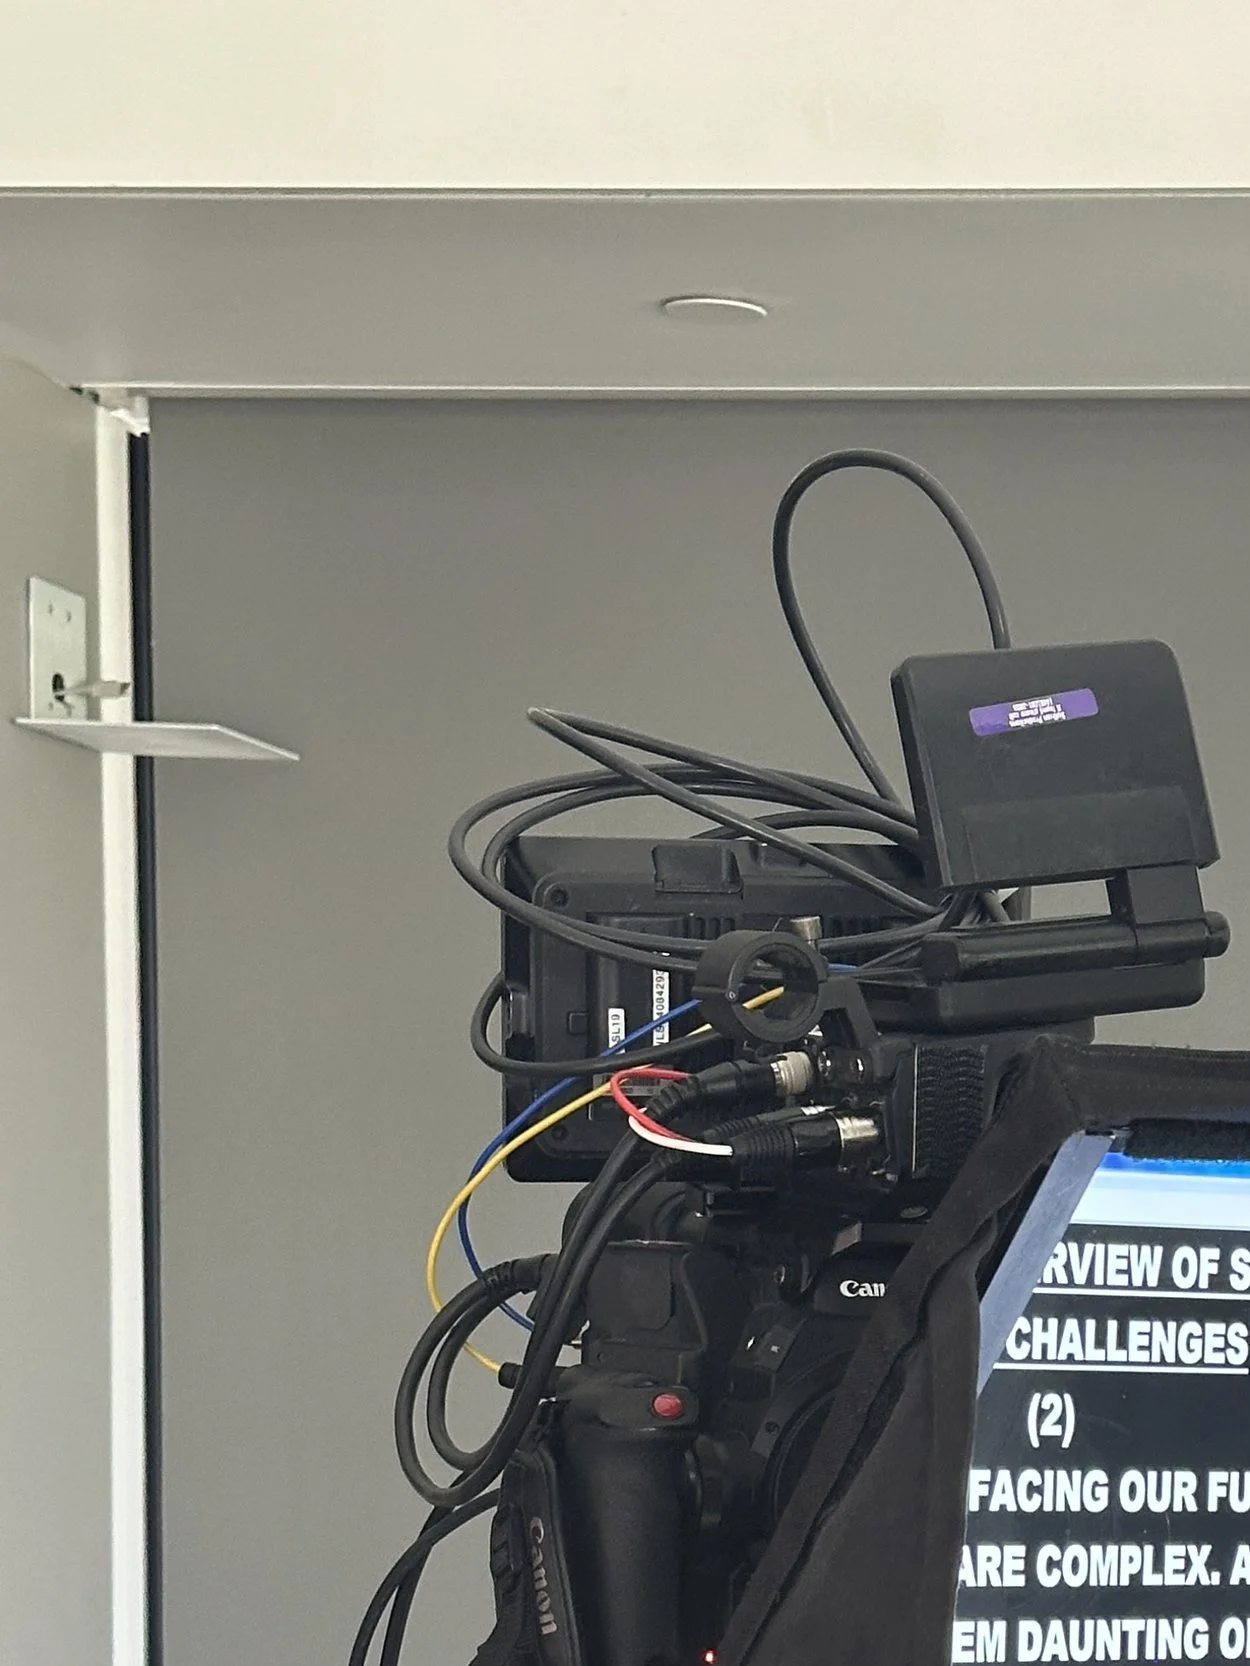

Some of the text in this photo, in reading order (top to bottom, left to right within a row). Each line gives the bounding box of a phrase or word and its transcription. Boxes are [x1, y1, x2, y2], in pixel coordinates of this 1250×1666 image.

[1036, 1243, 1163, 1289] RVIEW
[1172, 1245, 1223, 1290] OF
[1005, 1315, 1249, 1366] CHALLENGES
[1027, 1392, 1076, 1448] (2)
[968, 1469, 1109, 1512] FACING
[1119, 1470, 1199, 1513] OUR
[530, 1516, 557, 1635] Canon
[957, 1545, 1026, 1588] ARE
[1036, 1543, 1221, 1588] COMPLEX.
[952, 1619, 1006, 1663] EM
[1018, 1616, 1209, 1663] DAUNTING
